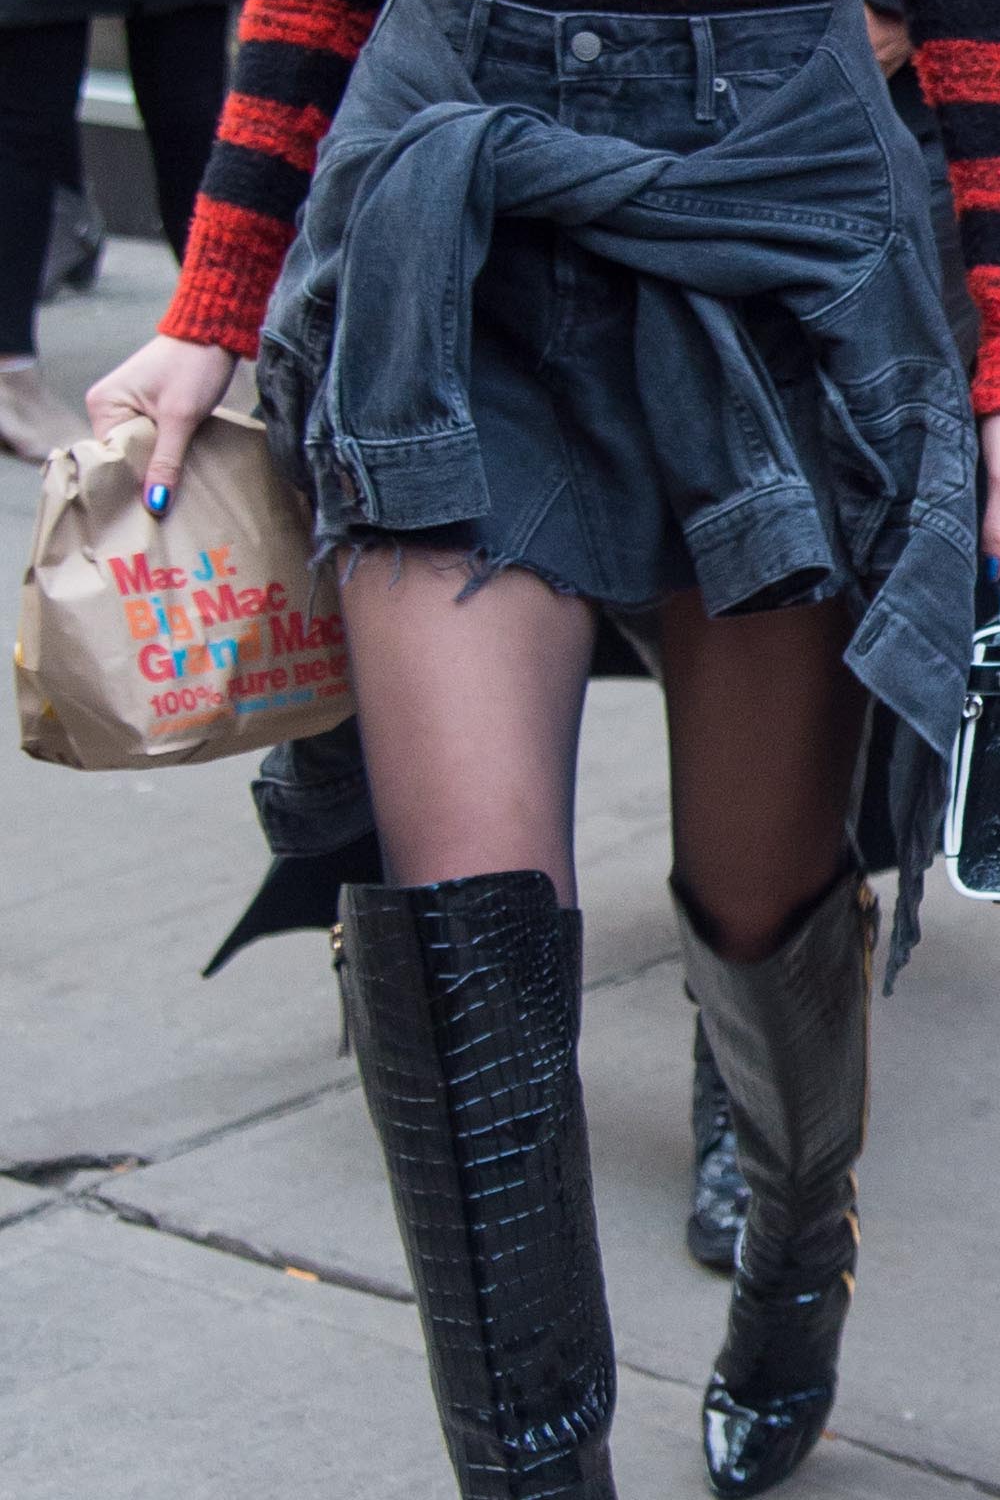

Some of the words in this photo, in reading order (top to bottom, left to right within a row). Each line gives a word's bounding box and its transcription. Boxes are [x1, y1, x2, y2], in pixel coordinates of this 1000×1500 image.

[107, 553, 187, 596] Mac
[192, 545, 237, 582] Jr.
[124, 596, 195, 641] Big
[192, 582, 288, 627] Mac
[138, 622, 260, 682] Grand
[269, 611, 346, 656] Mac
[150, 686, 223, 718] 100%
